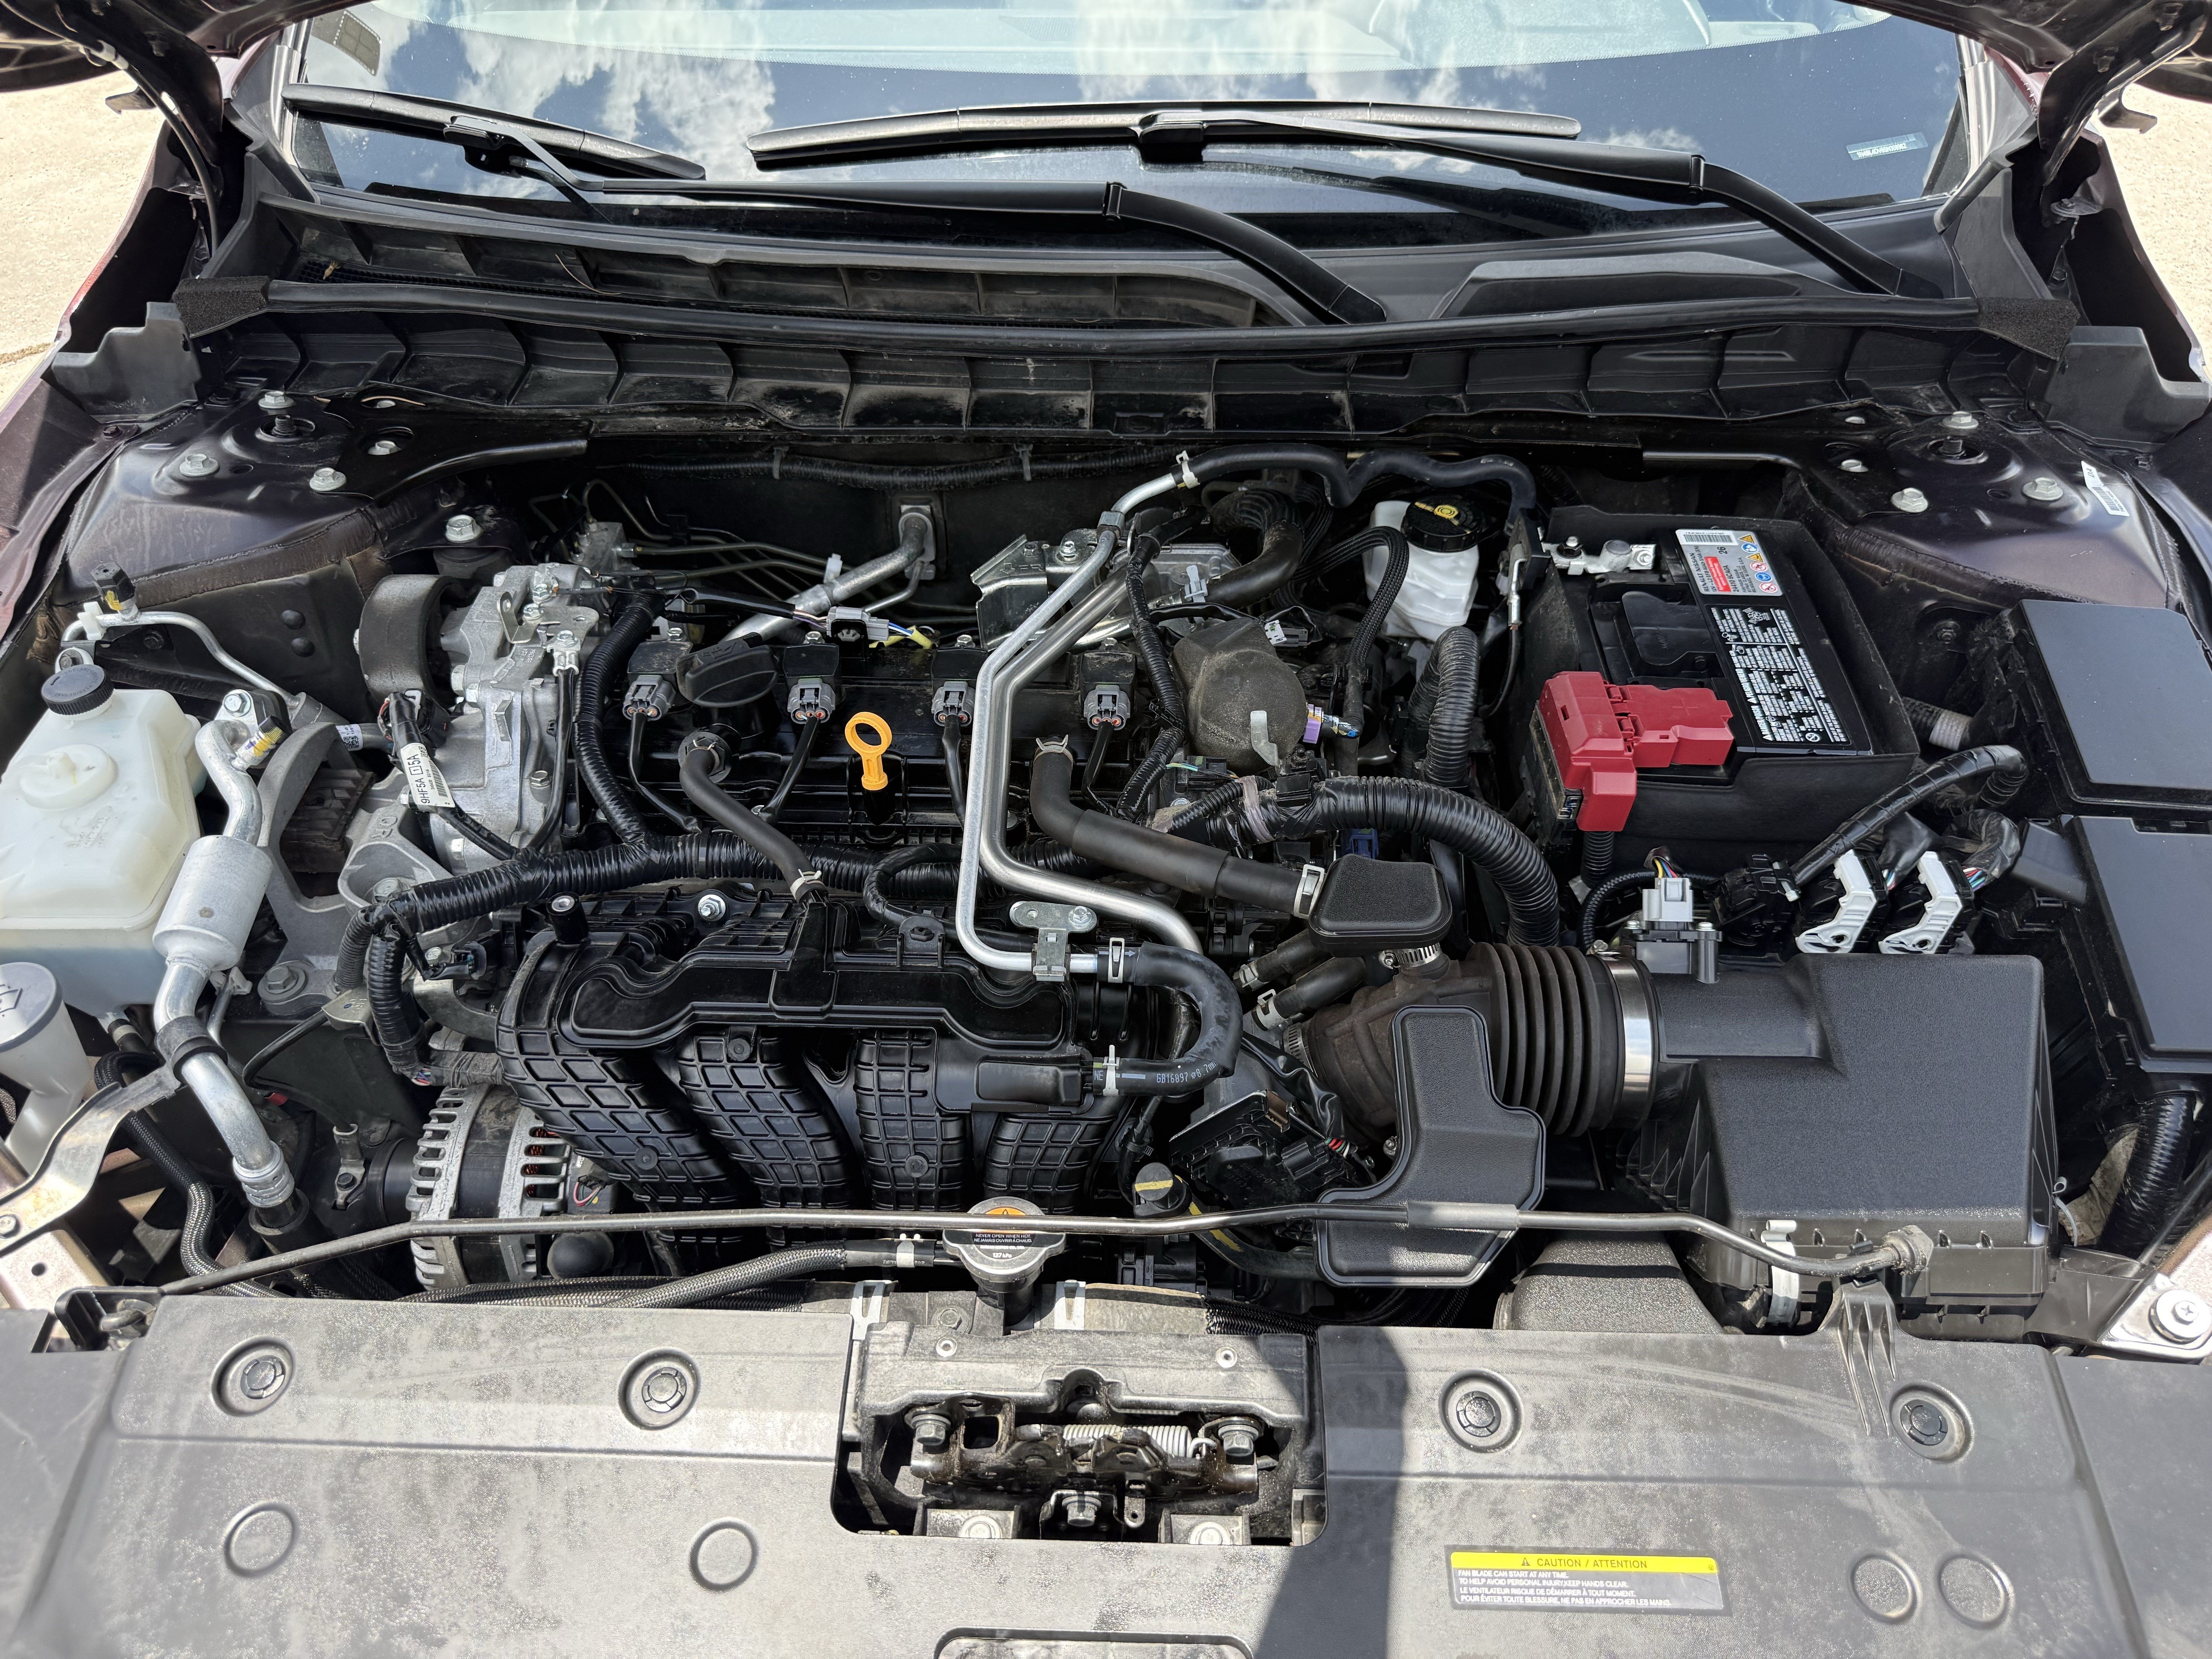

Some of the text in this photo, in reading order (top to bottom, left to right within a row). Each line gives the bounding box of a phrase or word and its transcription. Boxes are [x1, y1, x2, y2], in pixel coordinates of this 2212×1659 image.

[1688, 553, 1701, 571] NISSAN
[406, 754, 421, 765] 5A
[416, 777, 429, 803] 9HF5A
[1094, 1070, 1103, 1080] NE
[1156, 1072, 1188, 1083] GB16897
[1536, 1558, 1581, 1567] CAUTION
[1592, 1559, 1647, 1568] ATTENTION
[1546, 1587, 1582, 1596] DÉMARRER
[1480, 1593, 1503, 1602] ÉVITER
